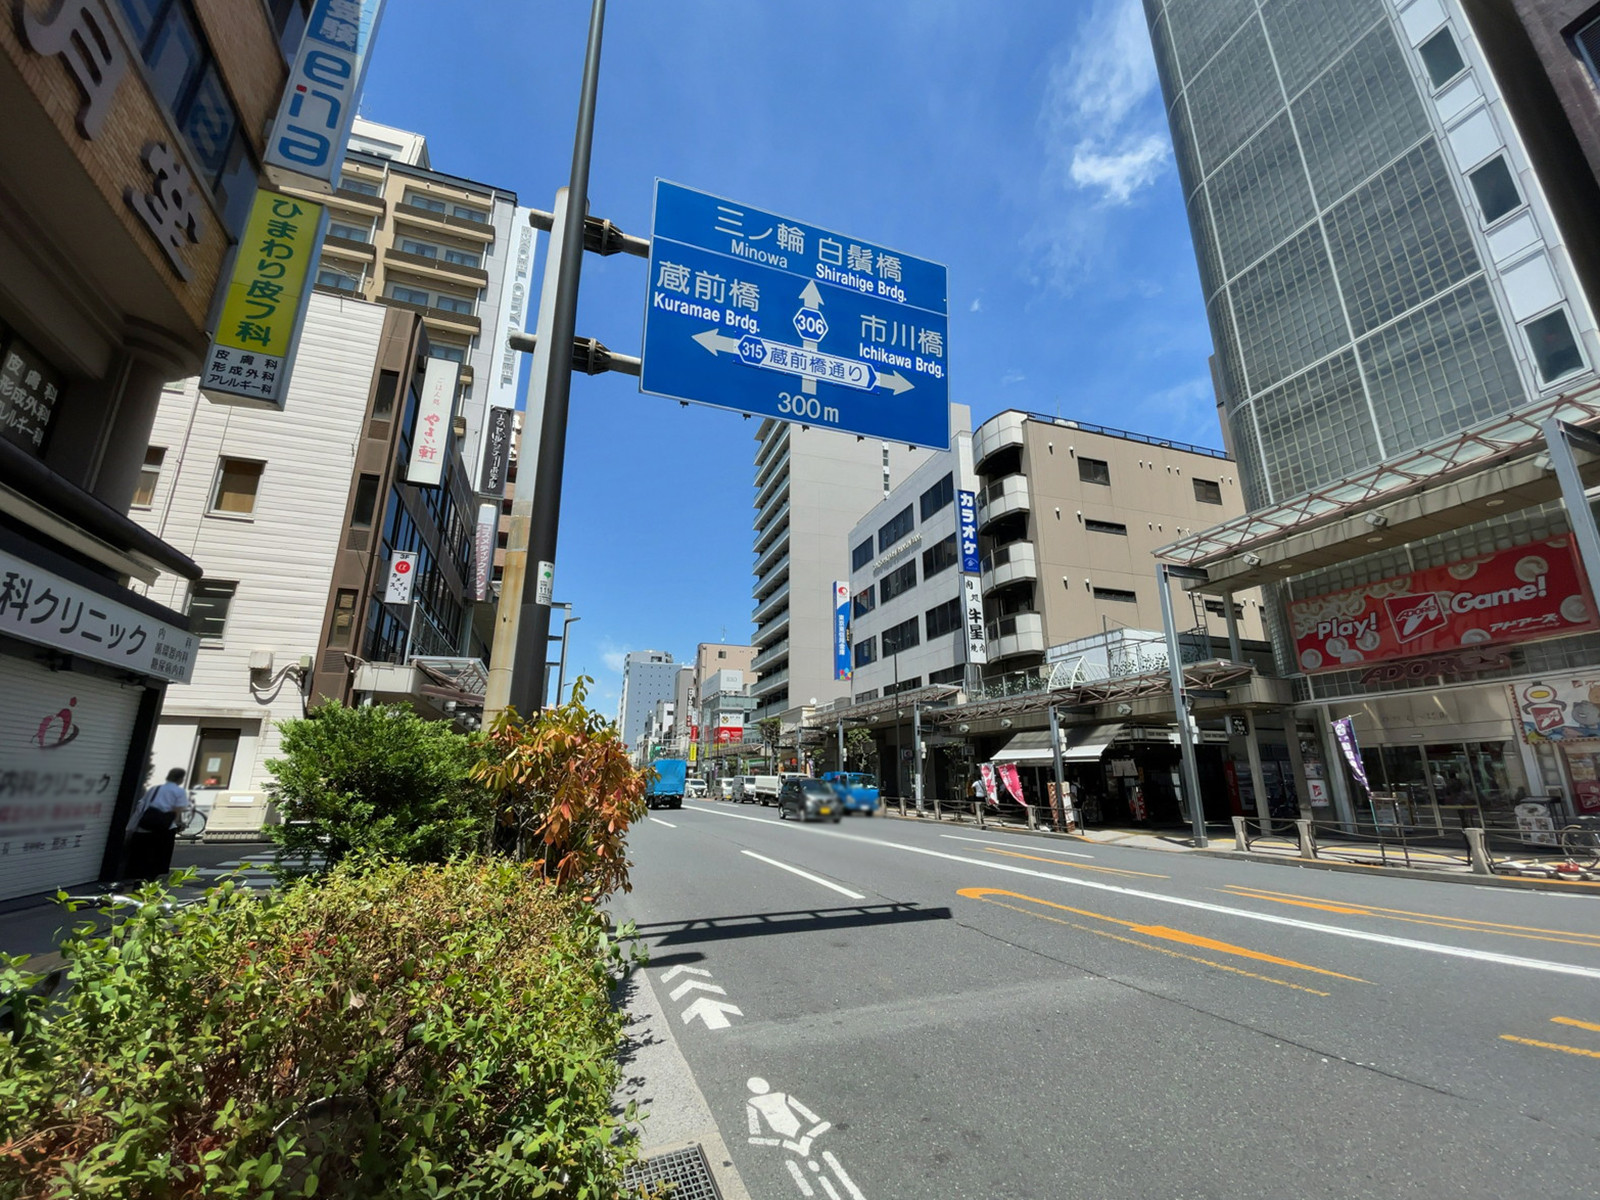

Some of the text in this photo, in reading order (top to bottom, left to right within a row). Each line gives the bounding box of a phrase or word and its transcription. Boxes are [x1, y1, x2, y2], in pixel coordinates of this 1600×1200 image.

[278, 50, 352, 167] ena
[714, 205, 806, 255] 三ノ輪
[235, 198, 303, 347] ひまわり皮フ科
[731, 239, 788, 269] Minowa
[656, 260, 761, 313] 蔵前橋
[815, 263, 908, 302] Shirahige Brdg.
[509, 283, 525, 327] CITY
[653, 291, 761, 333] Kuramae Brdg.
[797, 313, 825, 335] 306
[741, 339, 764, 360] 315
[859, 313, 944, 358] 市川橋
[211, 361, 275, 383] 形成外科
[215, 349, 278, 370] 皮膚科
[500, 326, 518, 390] TEL
[769, 346, 864, 382] 蔵前橋通り
[858, 343, 946, 378] Ichikawa Brdg.
[6, 352, 58, 405] 皮膚科
[207, 373, 273, 395] アレルギー科
[960, 492, 977, 555] カラオケ
[0, 571, 148, 655] 科クリニック
[1451, 575, 1548, 614] Game!
[1317, 611, 1377, 641] Play!
